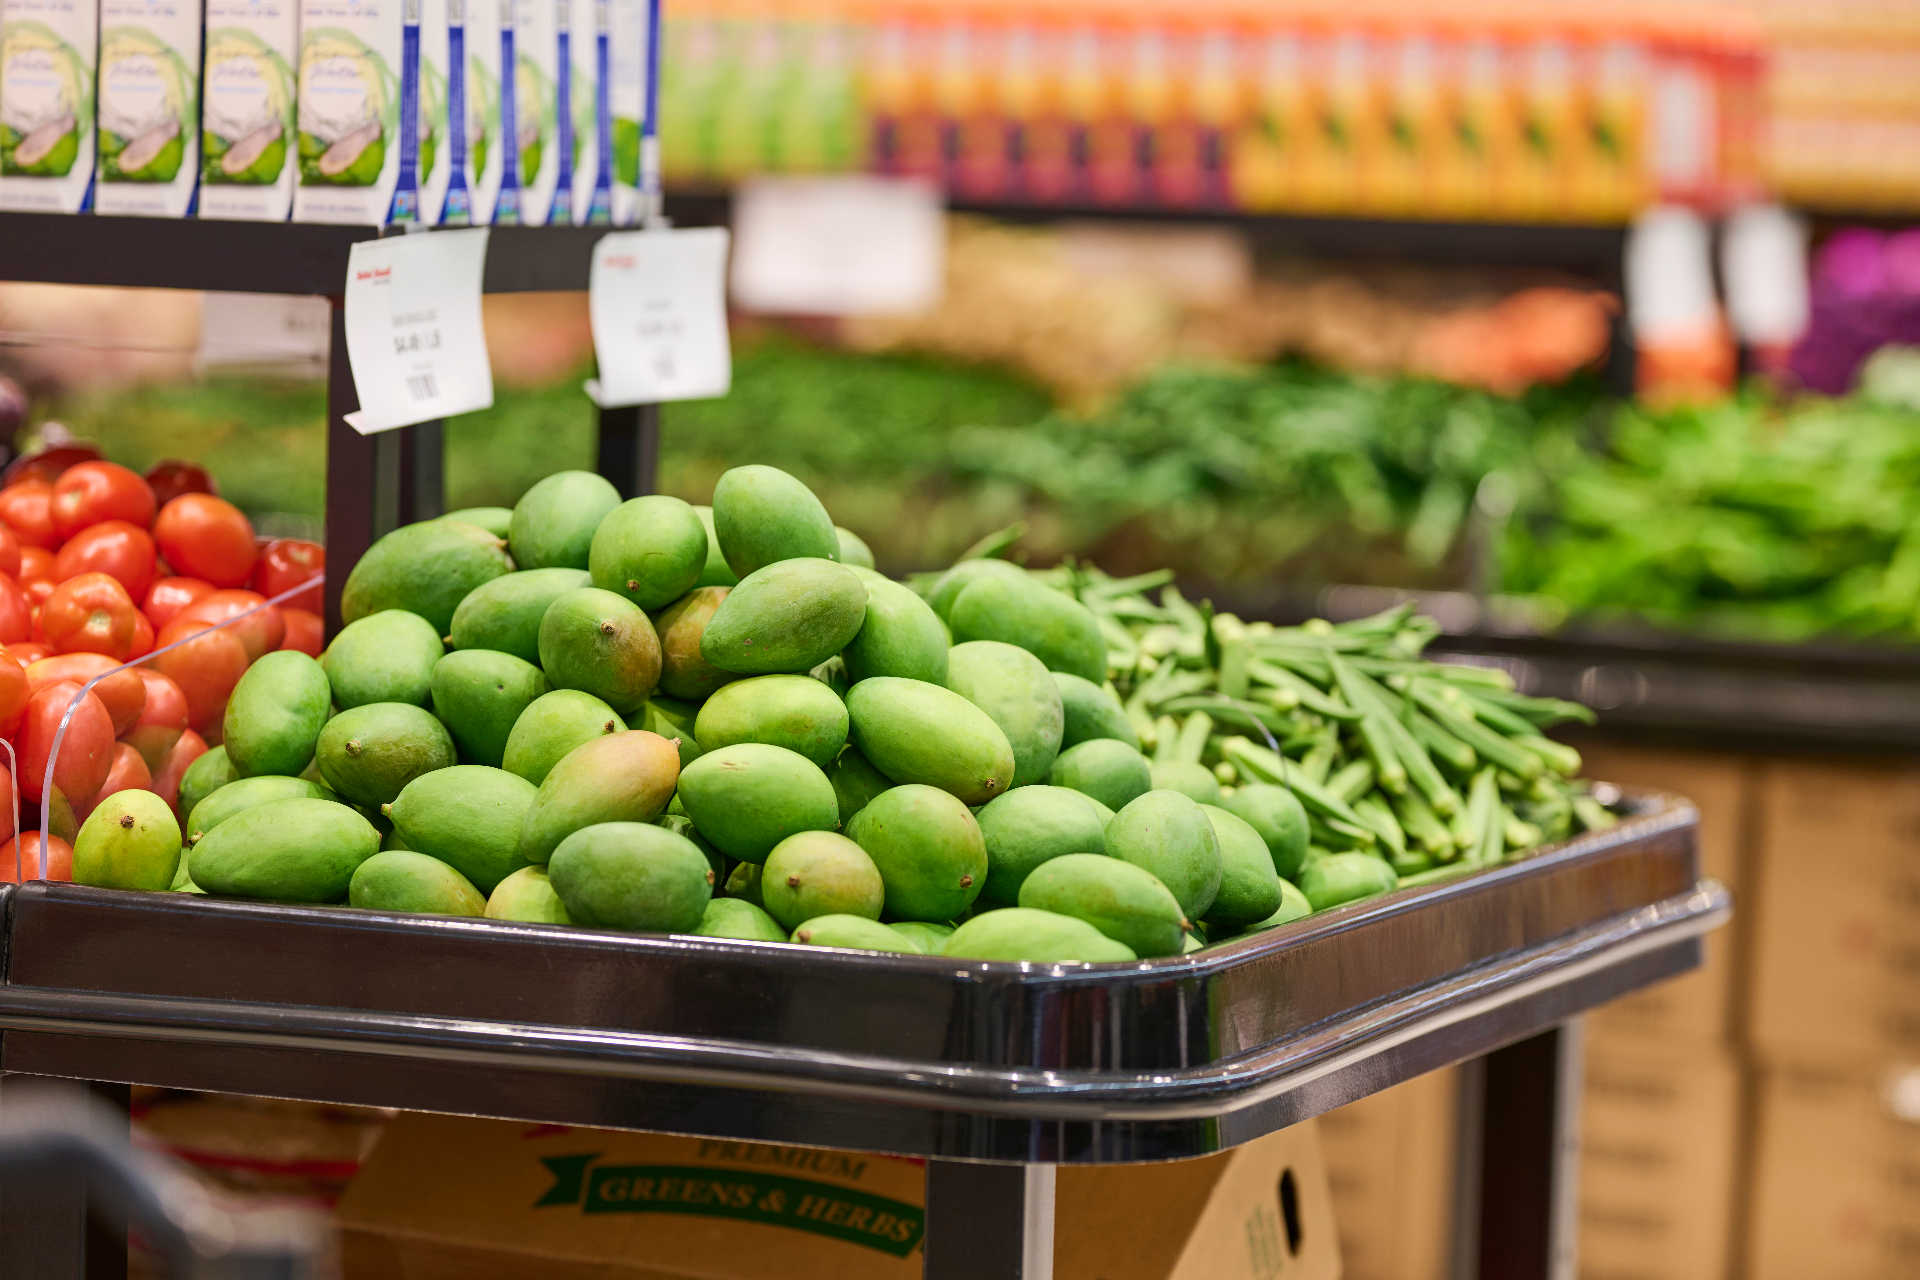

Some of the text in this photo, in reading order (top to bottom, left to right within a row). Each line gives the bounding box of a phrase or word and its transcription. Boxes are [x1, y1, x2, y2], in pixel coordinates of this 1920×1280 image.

[697, 1139, 869, 1180] PREMIUM
[599, 1176, 918, 1242] GREENS & HERBS
